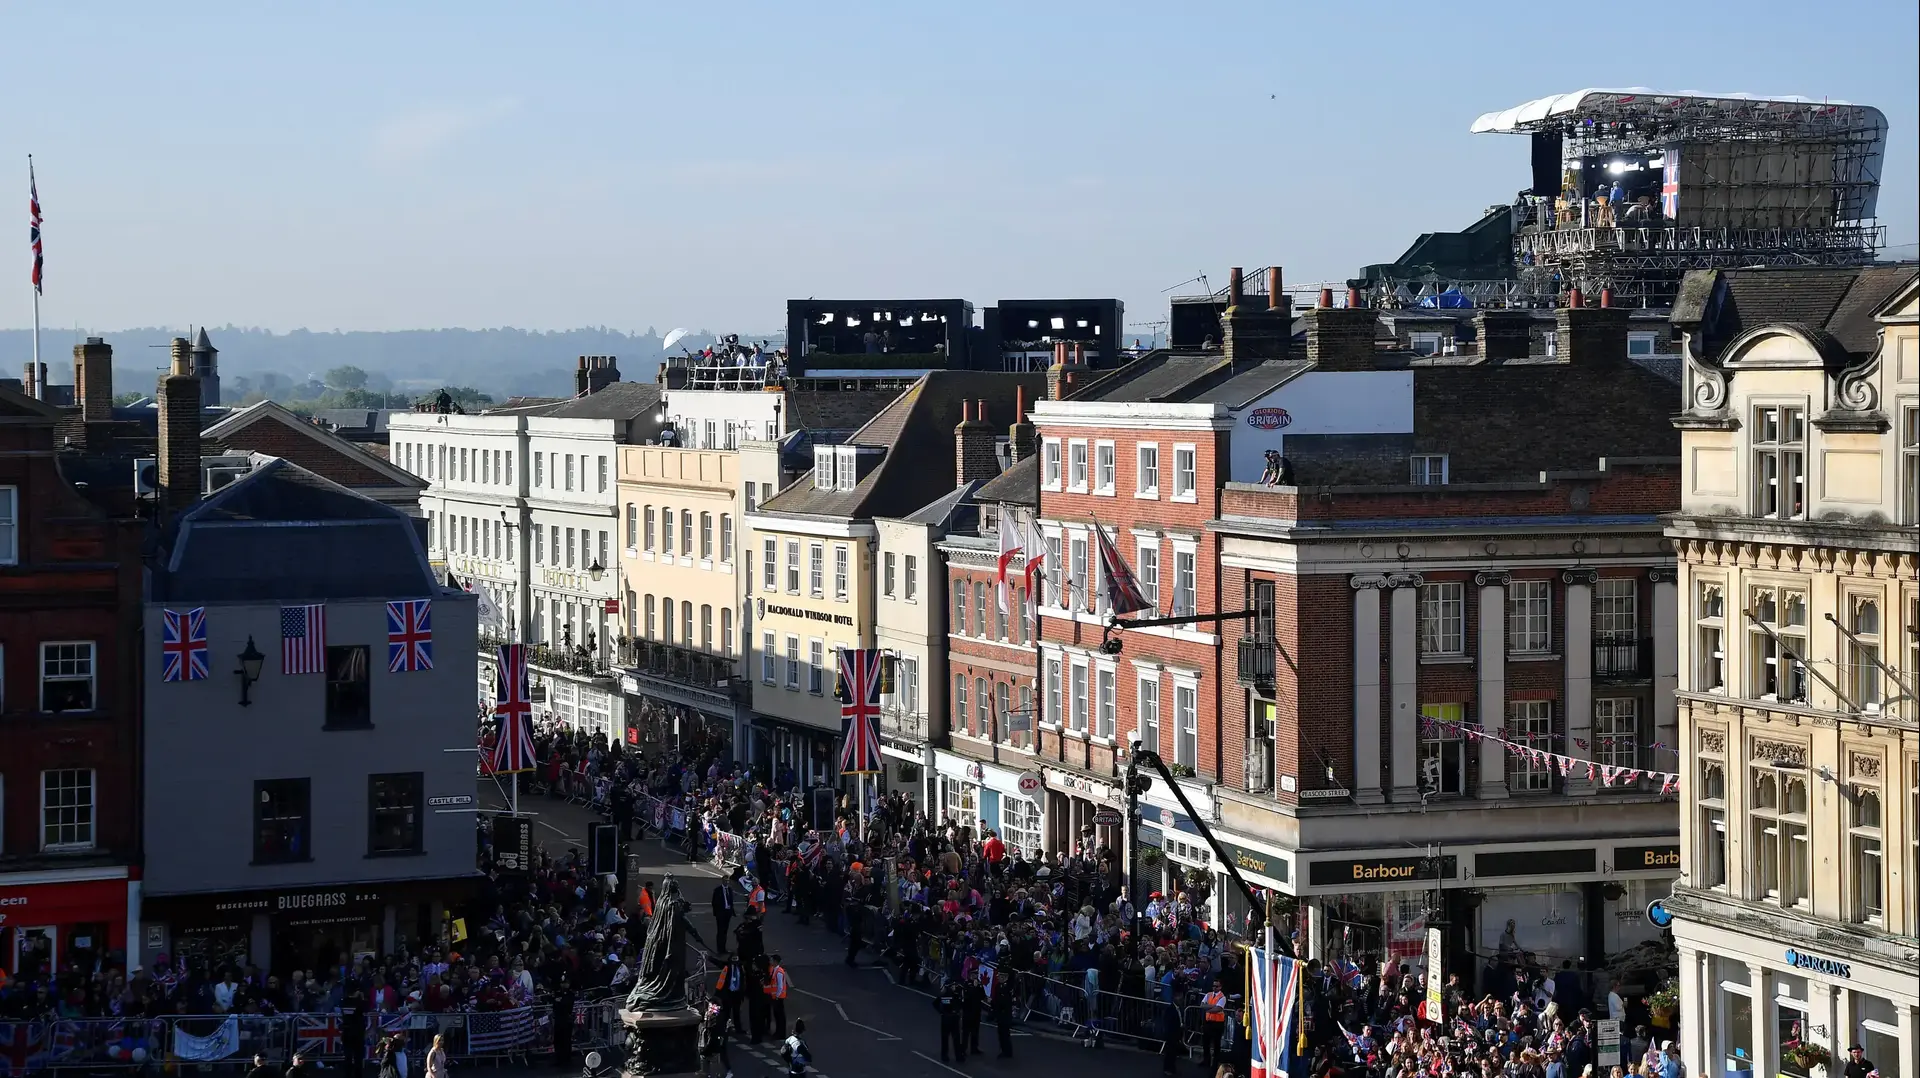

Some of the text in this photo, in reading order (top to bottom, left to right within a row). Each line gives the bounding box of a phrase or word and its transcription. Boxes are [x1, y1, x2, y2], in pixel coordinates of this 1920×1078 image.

[1249, 415, 1290, 425] BRITAIN
[767, 604, 854, 626] MACDONALD WINDSOR HOTEL
[1328, 788, 1348, 797] STREET
[1094, 815, 1120, 823] BRITAIN
[519, 823, 529, 871] BLUEGRASS
[1236, 849, 1267, 872] Barbour
[1353, 863, 1415, 879] Barbour
[215, 900, 269, 911] SMOKEHOUSE
[277, 892, 347, 910] BLUEGRASS
[1797, 952, 1850, 979] BARCLAYS
